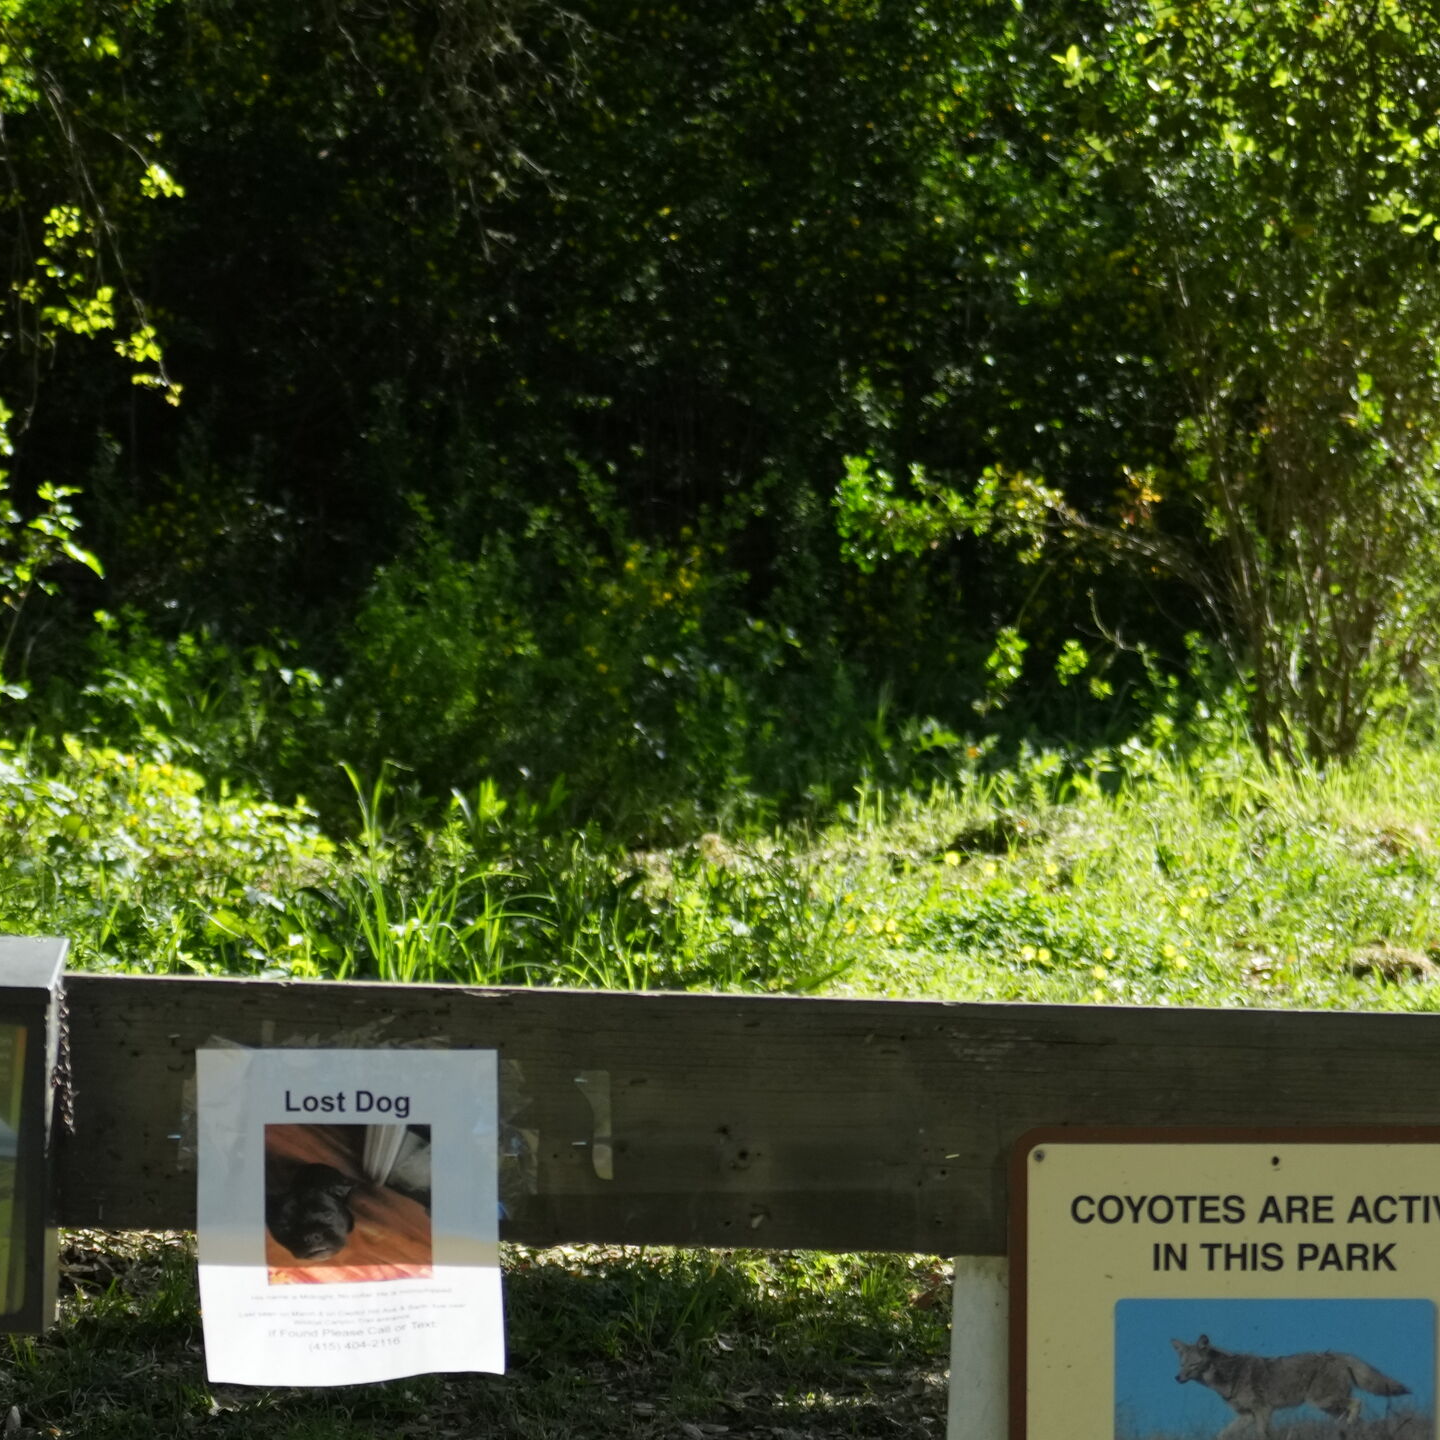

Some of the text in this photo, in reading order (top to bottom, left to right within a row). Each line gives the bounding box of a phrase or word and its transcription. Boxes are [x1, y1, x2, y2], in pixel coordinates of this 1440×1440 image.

[285, 1090, 410, 1118] Lost Dog
[1070, 1195, 1245, 1224] COYOTES
[1258, 1196, 1334, 1224] ARE
[1152, 1243, 1397, 1272] IN THIS PARK
[279, 1328, 318, 1338] Found
[322, 1327, 364, 1337] Please
[368, 1325, 390, 1335] Call
